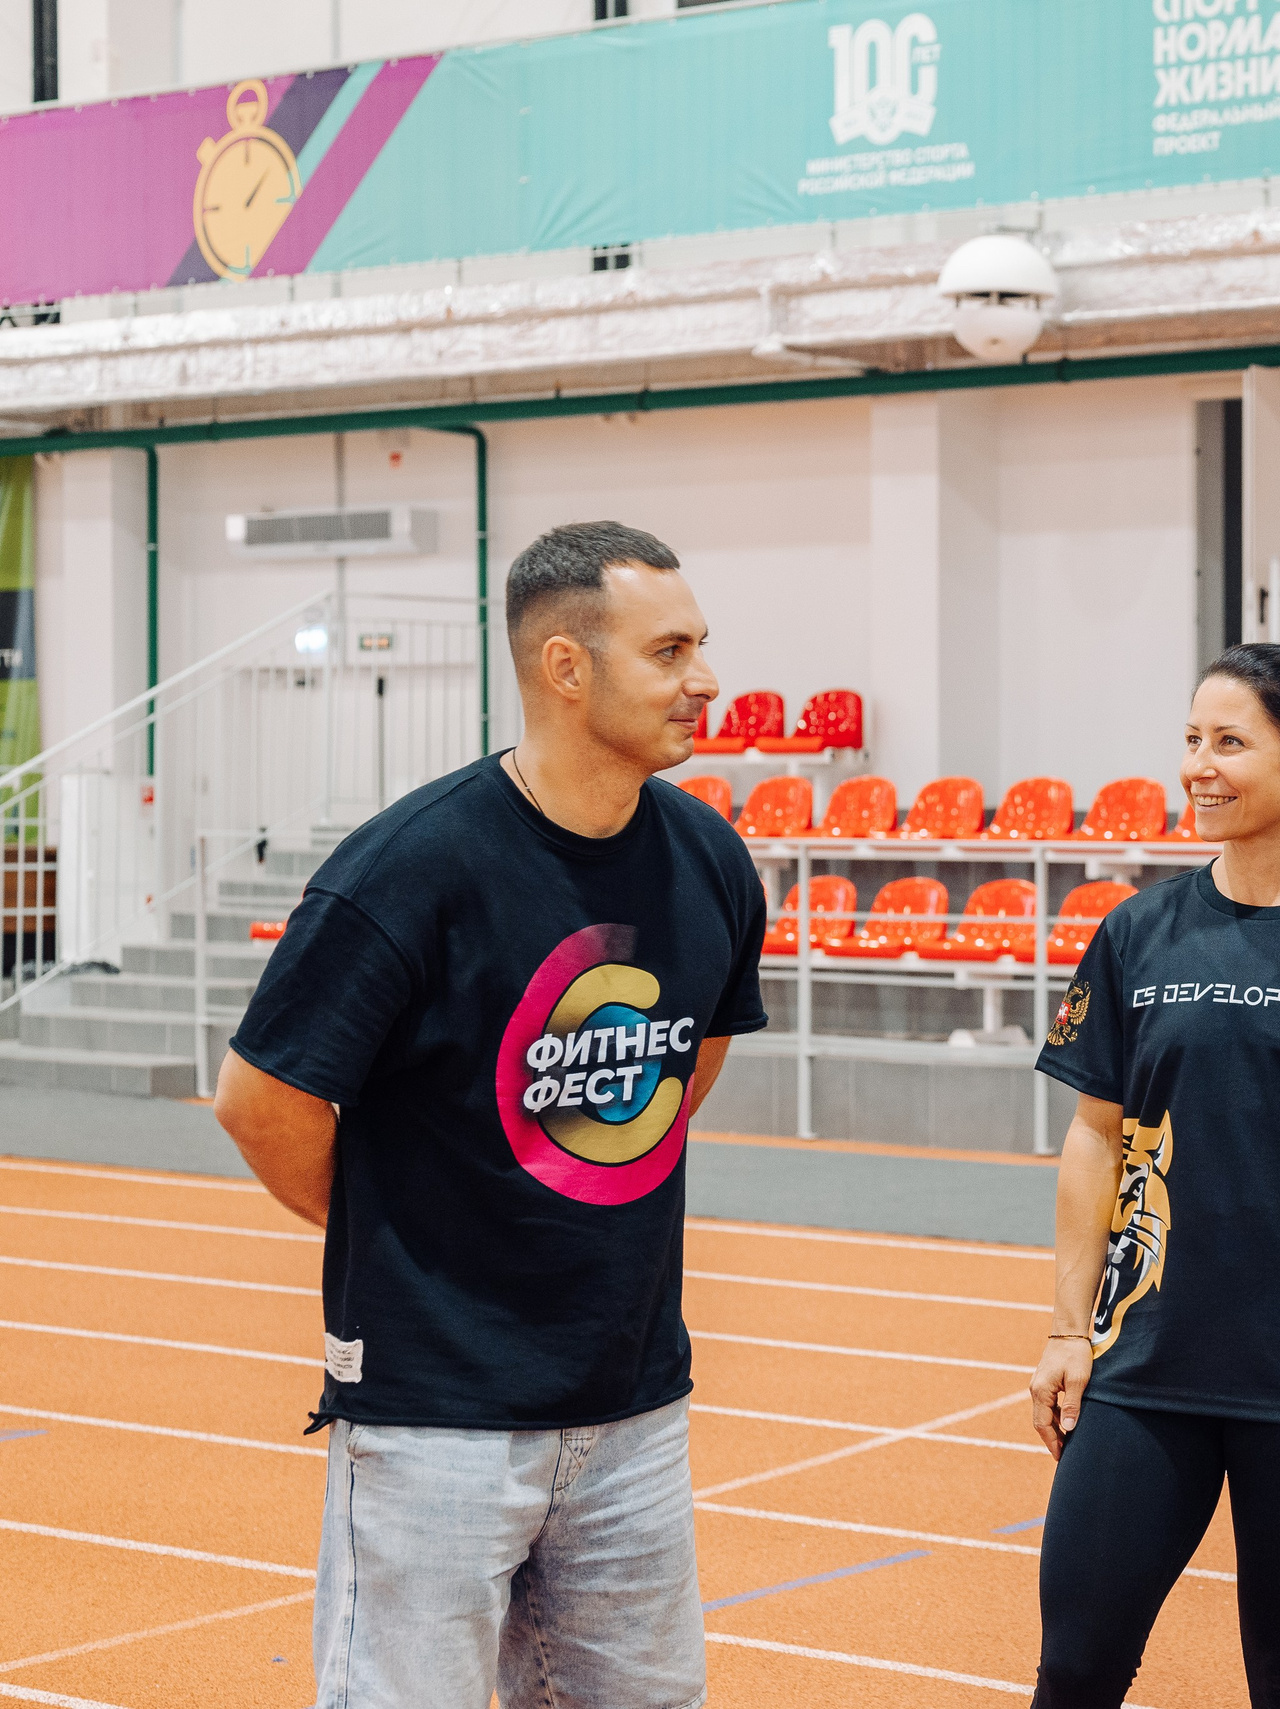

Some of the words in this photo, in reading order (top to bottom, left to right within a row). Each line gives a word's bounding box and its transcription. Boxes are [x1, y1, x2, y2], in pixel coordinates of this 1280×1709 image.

[1152, 130, 1222, 156] ПРОЕКТ
[1132, 985, 1157, 1008] CS
[525, 1016, 695, 1072] ФИТНЕС
[522, 1065, 643, 1113] ФЕСТ
